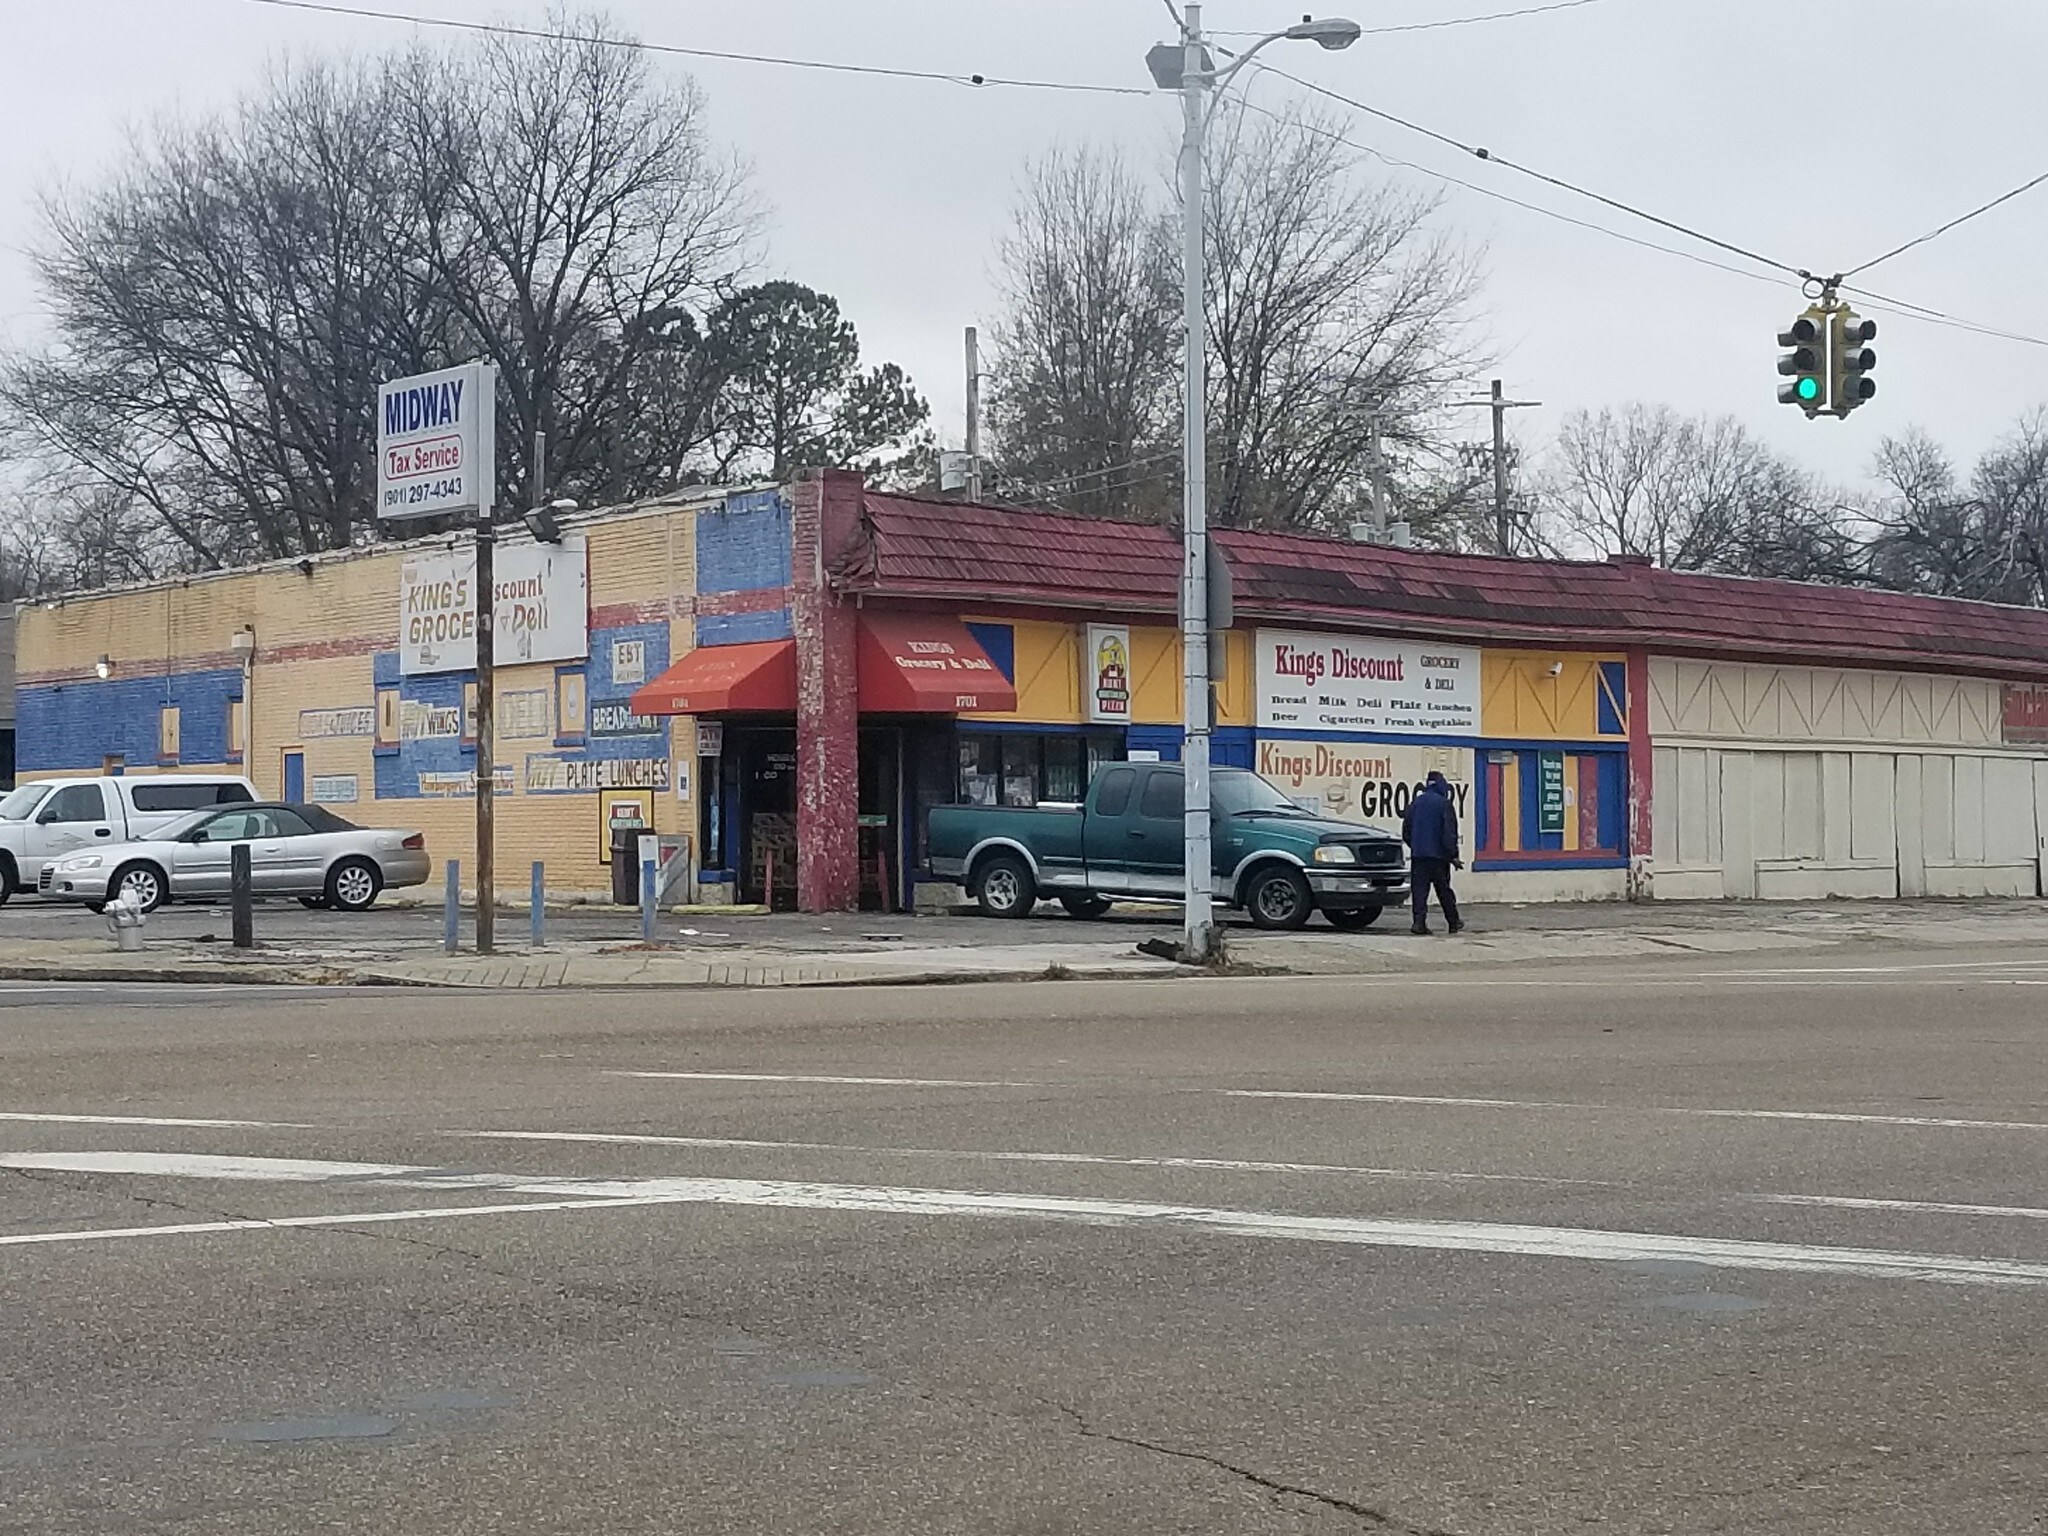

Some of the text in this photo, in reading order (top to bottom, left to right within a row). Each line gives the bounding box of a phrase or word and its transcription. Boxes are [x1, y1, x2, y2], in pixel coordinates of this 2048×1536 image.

[385, 379, 464, 435] MIDWAY
[389, 443, 459, 474] Tax Service
[384, 477, 462, 507] (901) 297-4343
[494, 570, 543, 602] scount
[409, 610, 497, 645] GROCE
[512, 596, 548, 634] Deli
[618, 643, 641, 664] EBT
[1332, 648, 1404, 681] Discount
[1420, 655, 1460, 669] GROCERY
[1424, 677, 1454, 690] & DELI
[956, 695, 978, 707] 1701
[1271, 696, 1307, 704] Bread
[1319, 696, 1347, 706] Milk
[1357, 698, 1382, 708] Deli
[1427, 702, 1472, 712] Lunches
[426, 709, 459, 735] WINGS
[1272, 713, 1472, 729] Beer Cigarettes Fresh Vegetables
[566, 761, 602, 788] PLATE
[609, 759, 668, 786] LUNCHES
[1315, 744, 1392, 778] Discount
[1361, 781, 1469, 818] GROY
